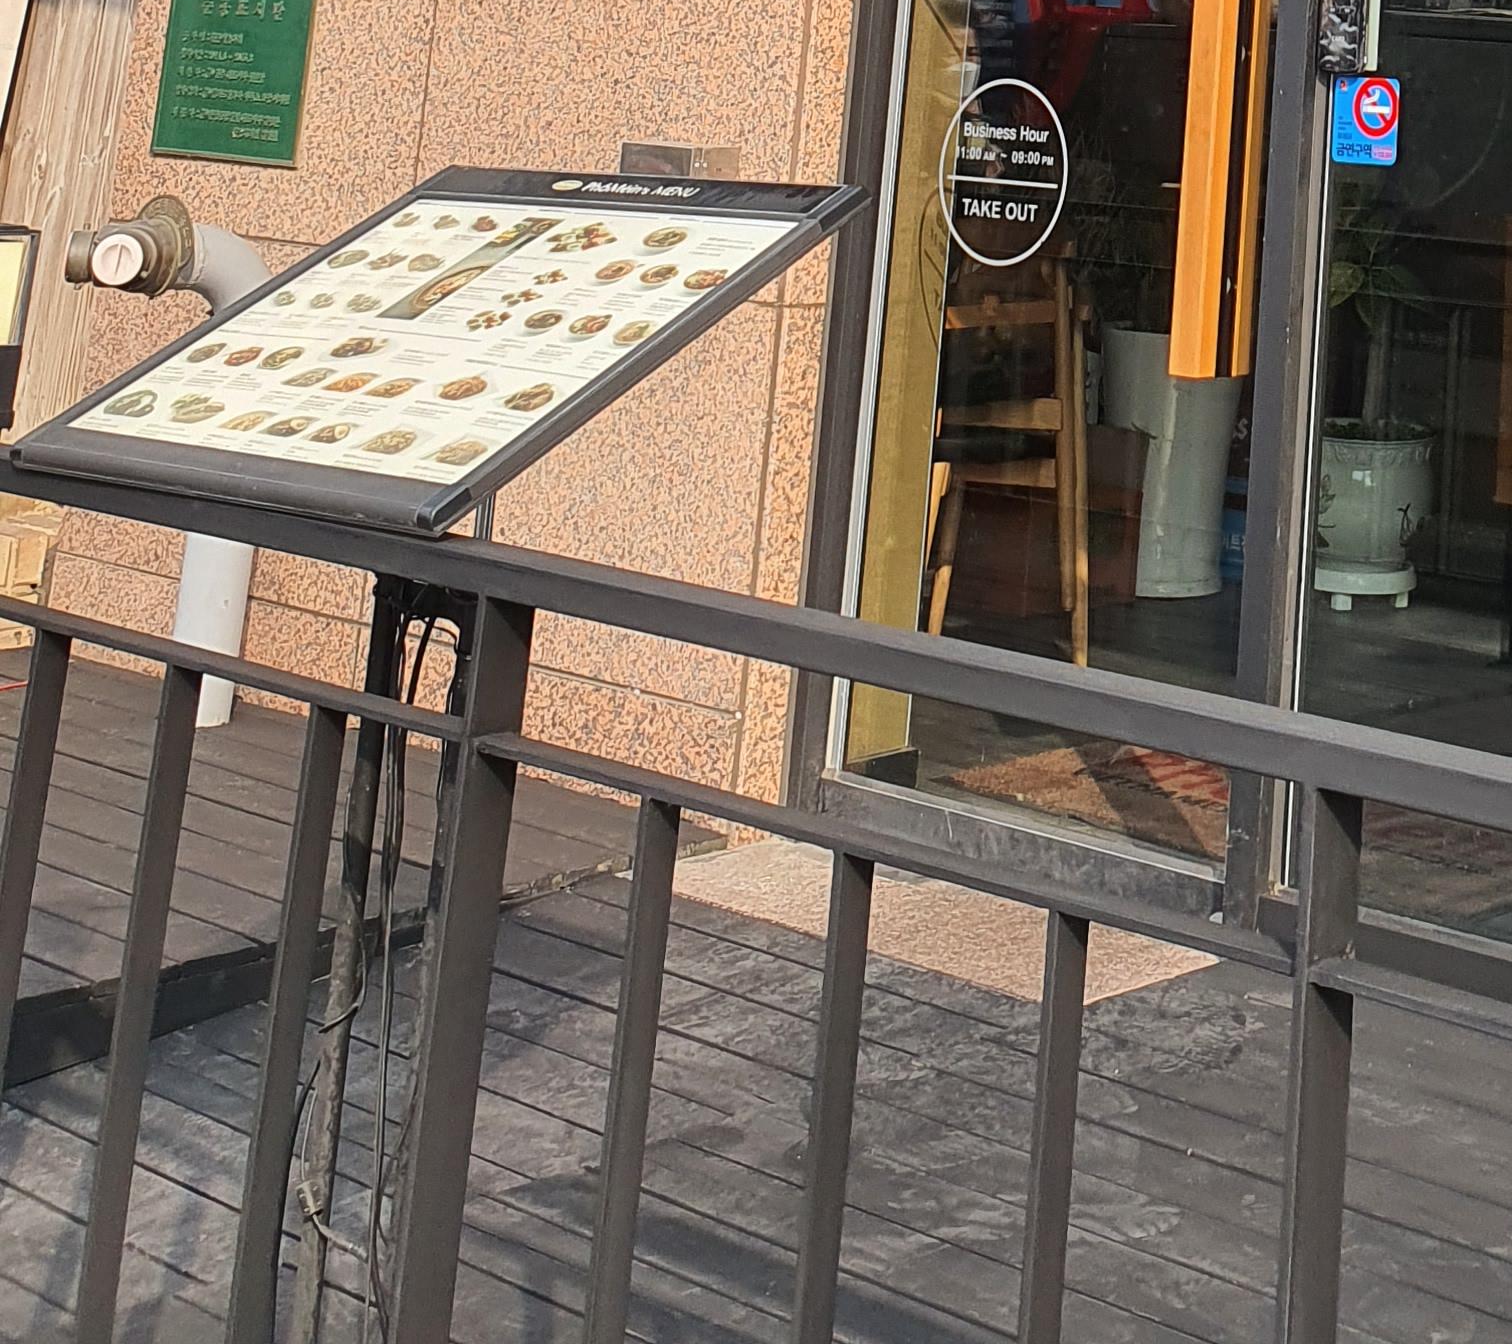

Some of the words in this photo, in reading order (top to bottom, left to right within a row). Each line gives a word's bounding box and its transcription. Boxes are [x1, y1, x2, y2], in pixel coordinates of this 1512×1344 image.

[963, 121, 1017, 141] Business
[1020, 125, 1050, 143] Hour
[983, 151, 996, 161] AM
[1011, 150, 1040, 165] 09:00
[1041, 155, 1054, 167] PM
[962, 198, 1002, 218] TAKE
[1005, 202, 1039, 223] OUT
